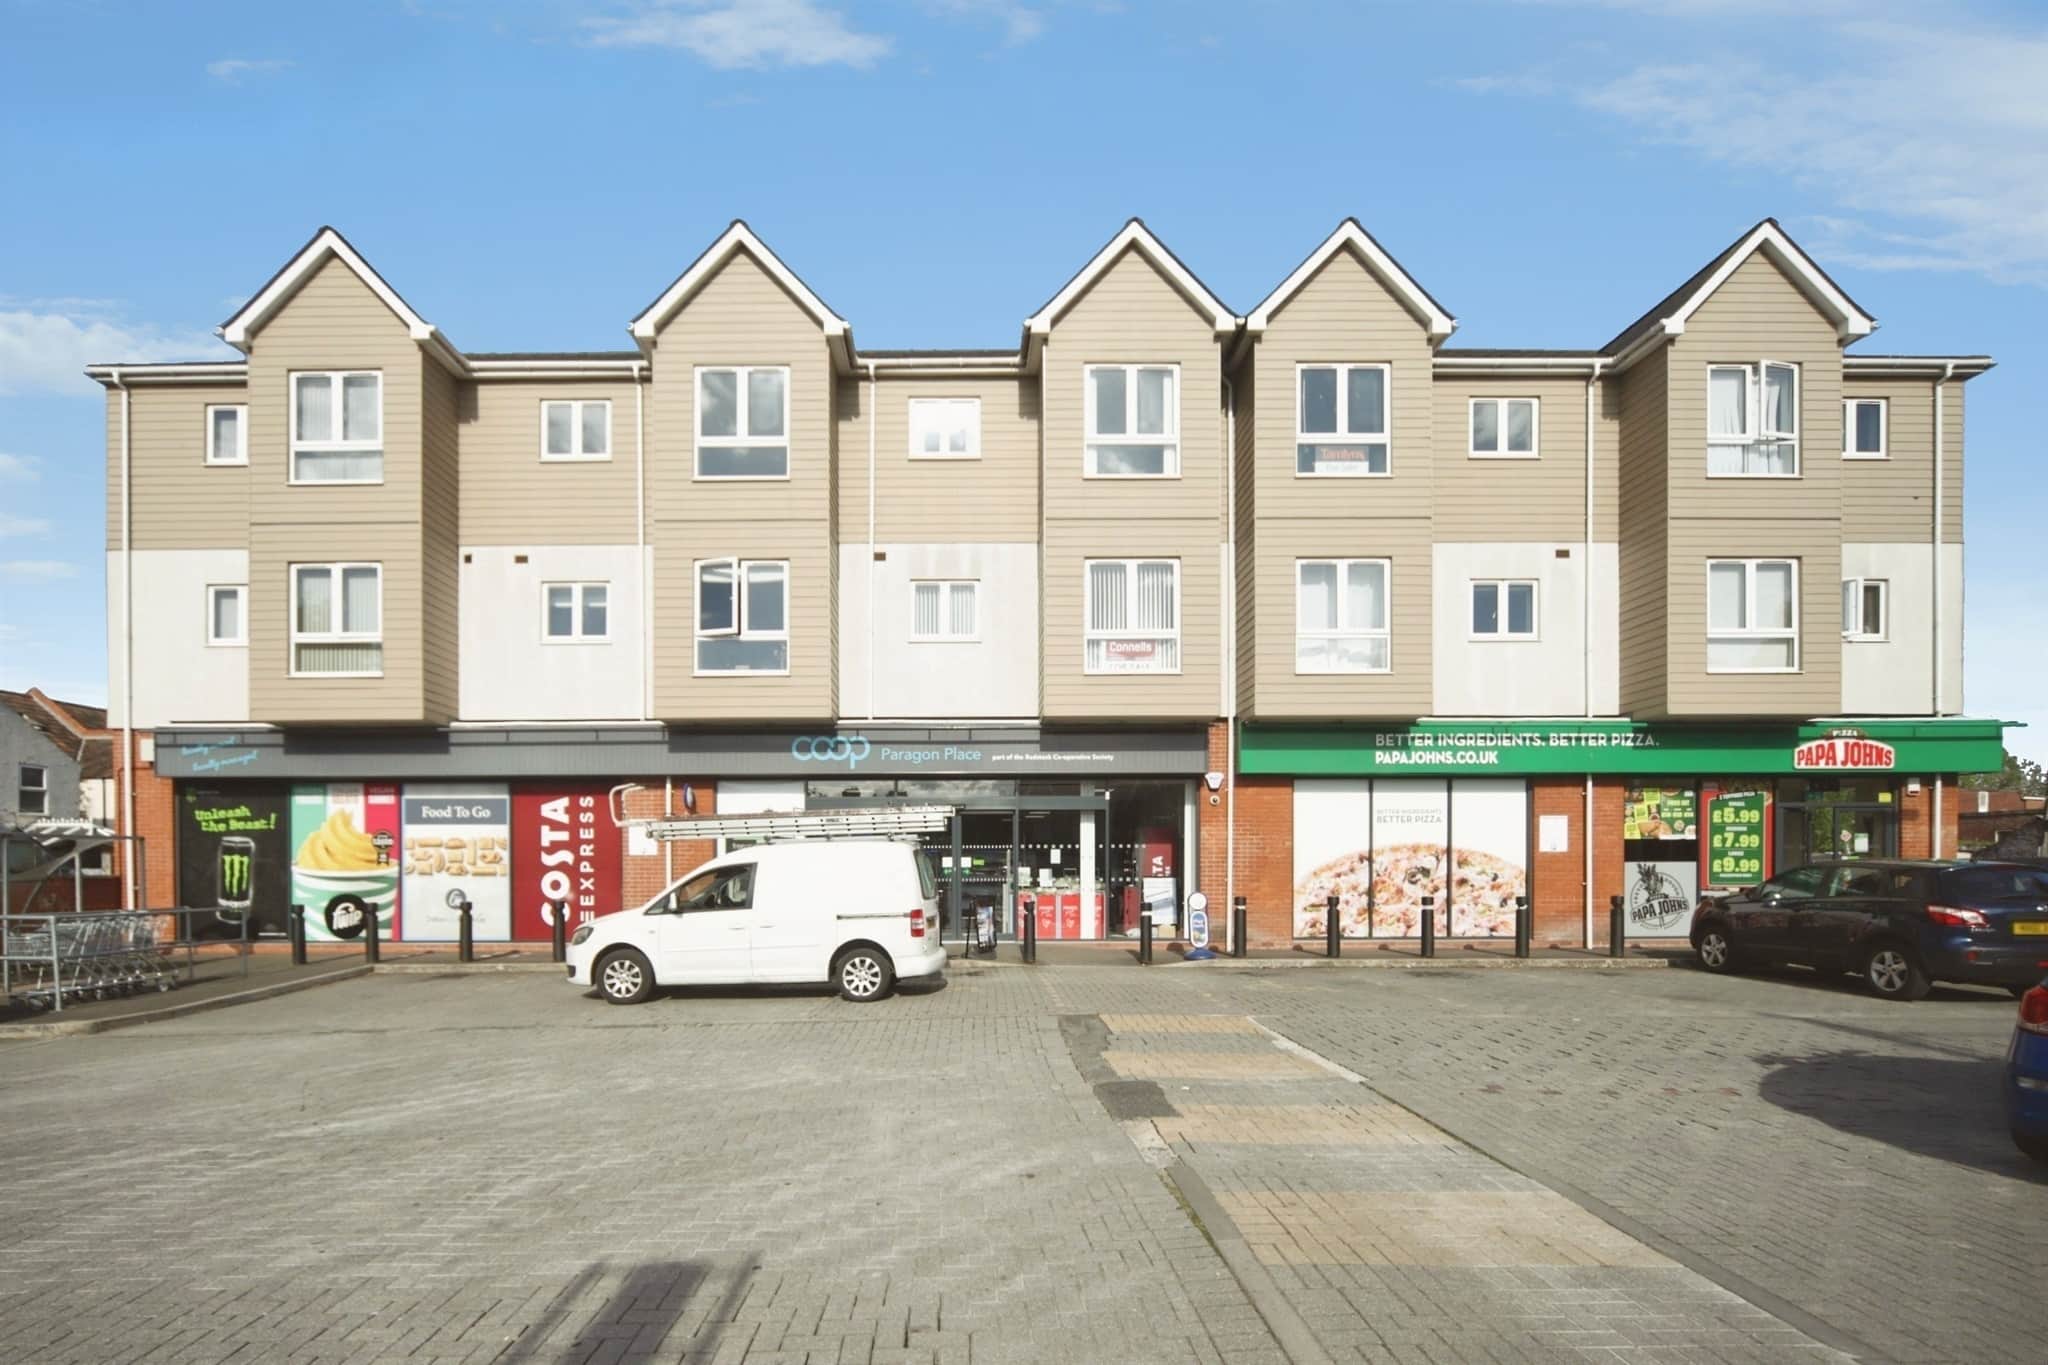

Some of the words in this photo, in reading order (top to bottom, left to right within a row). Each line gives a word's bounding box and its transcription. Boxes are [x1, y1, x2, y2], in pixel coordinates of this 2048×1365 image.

[1109, 640, 1153, 653] Connells
[1375, 732, 1433, 747] BETTER
[1437, 732, 1546, 747] INGREDIENTS.
[1549, 732, 1607, 747] BETTER
[1610, 733, 1660, 747] PIZZA.
[1832, 729, 1858, 737] PIZZA
[880, 748, 940, 764] Paragon
[944, 746, 982, 761] Place
[1014, 752, 1024, 761] the
[1375, 750, 1499, 765] PAPAJOHNS.CO.UK
[1796, 742, 1837, 767] PAPA
[1841, 741, 1892, 767] JOHNS
[194, 805, 251, 821] Unleash
[421, 805, 452, 819] Food
[453, 806, 470, 819] To
[471, 806, 492, 819] Go
[1376, 815, 1412, 824] BETTER
[1414, 815, 1443, 824] PIZZA
[1712, 807, 1760, 823] £5.99
[201, 820, 227, 832] the
[1712, 832, 1760, 848] £7.99
[579, 796, 595, 906] EXPRESS
[541, 796, 575, 927] COSTA
[1712, 857, 1760, 873] £9.99
[1632, 903, 1657, 921] PAPA
[1657, 899, 1689, 915] JOHNS
